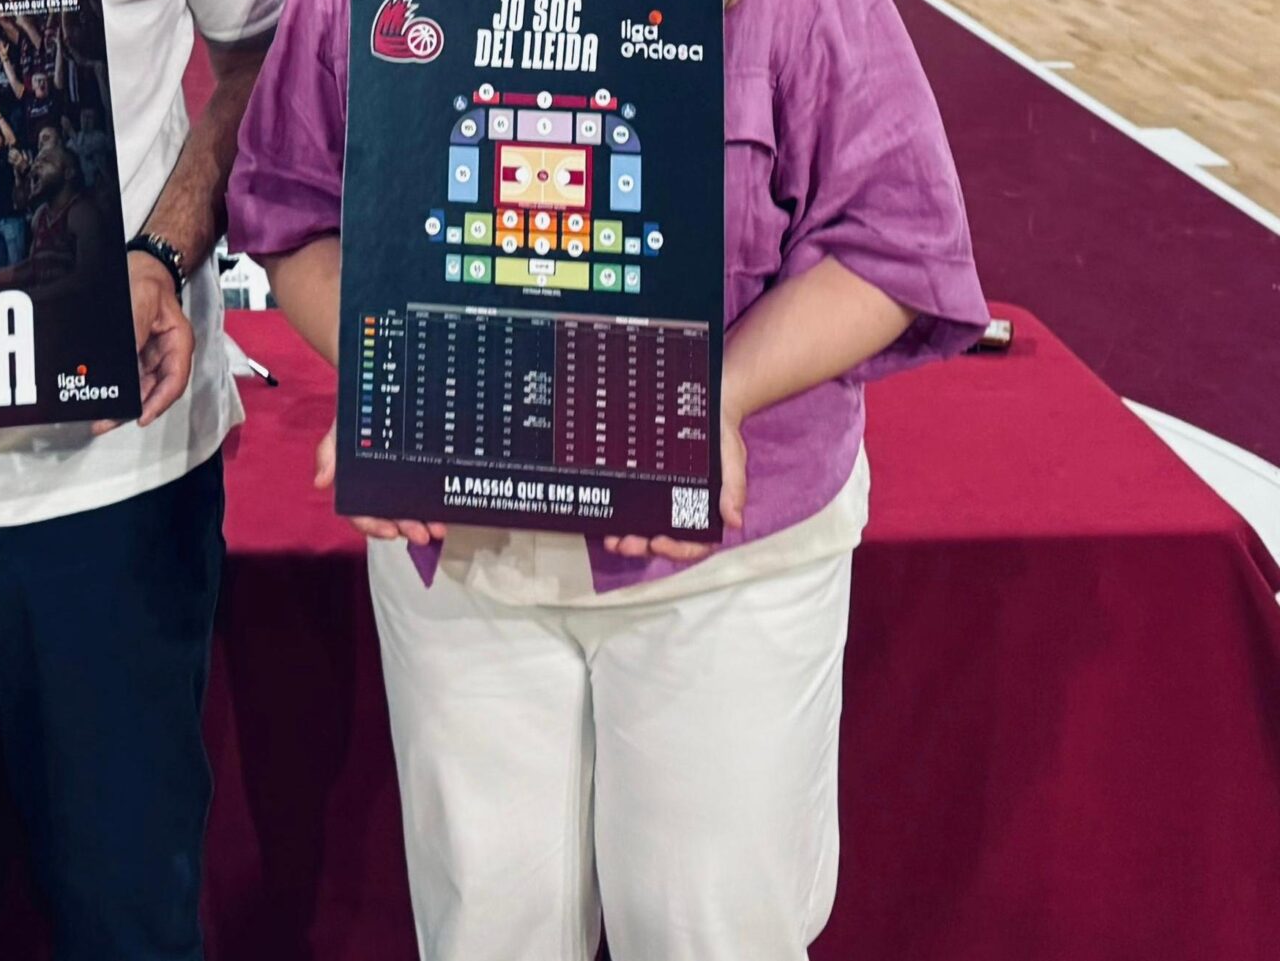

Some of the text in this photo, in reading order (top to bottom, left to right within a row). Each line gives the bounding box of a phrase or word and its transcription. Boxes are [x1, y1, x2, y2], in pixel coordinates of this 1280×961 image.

[620, 19, 659, 41] liga
[473, 28, 599, 73] DEL LLEIDA
[620, 40, 704, 62] endesa
[57, 372, 86, 390] liga
[59, 385, 119, 402] endesa
[444, 475, 611, 506] LA PASSIÓ QUE ENS MOU
[443, 494, 488, 508] CAMPANYA
[490, 497, 548, 513] ABONAMENTS
[550, 502, 577, 515] TEMP.
